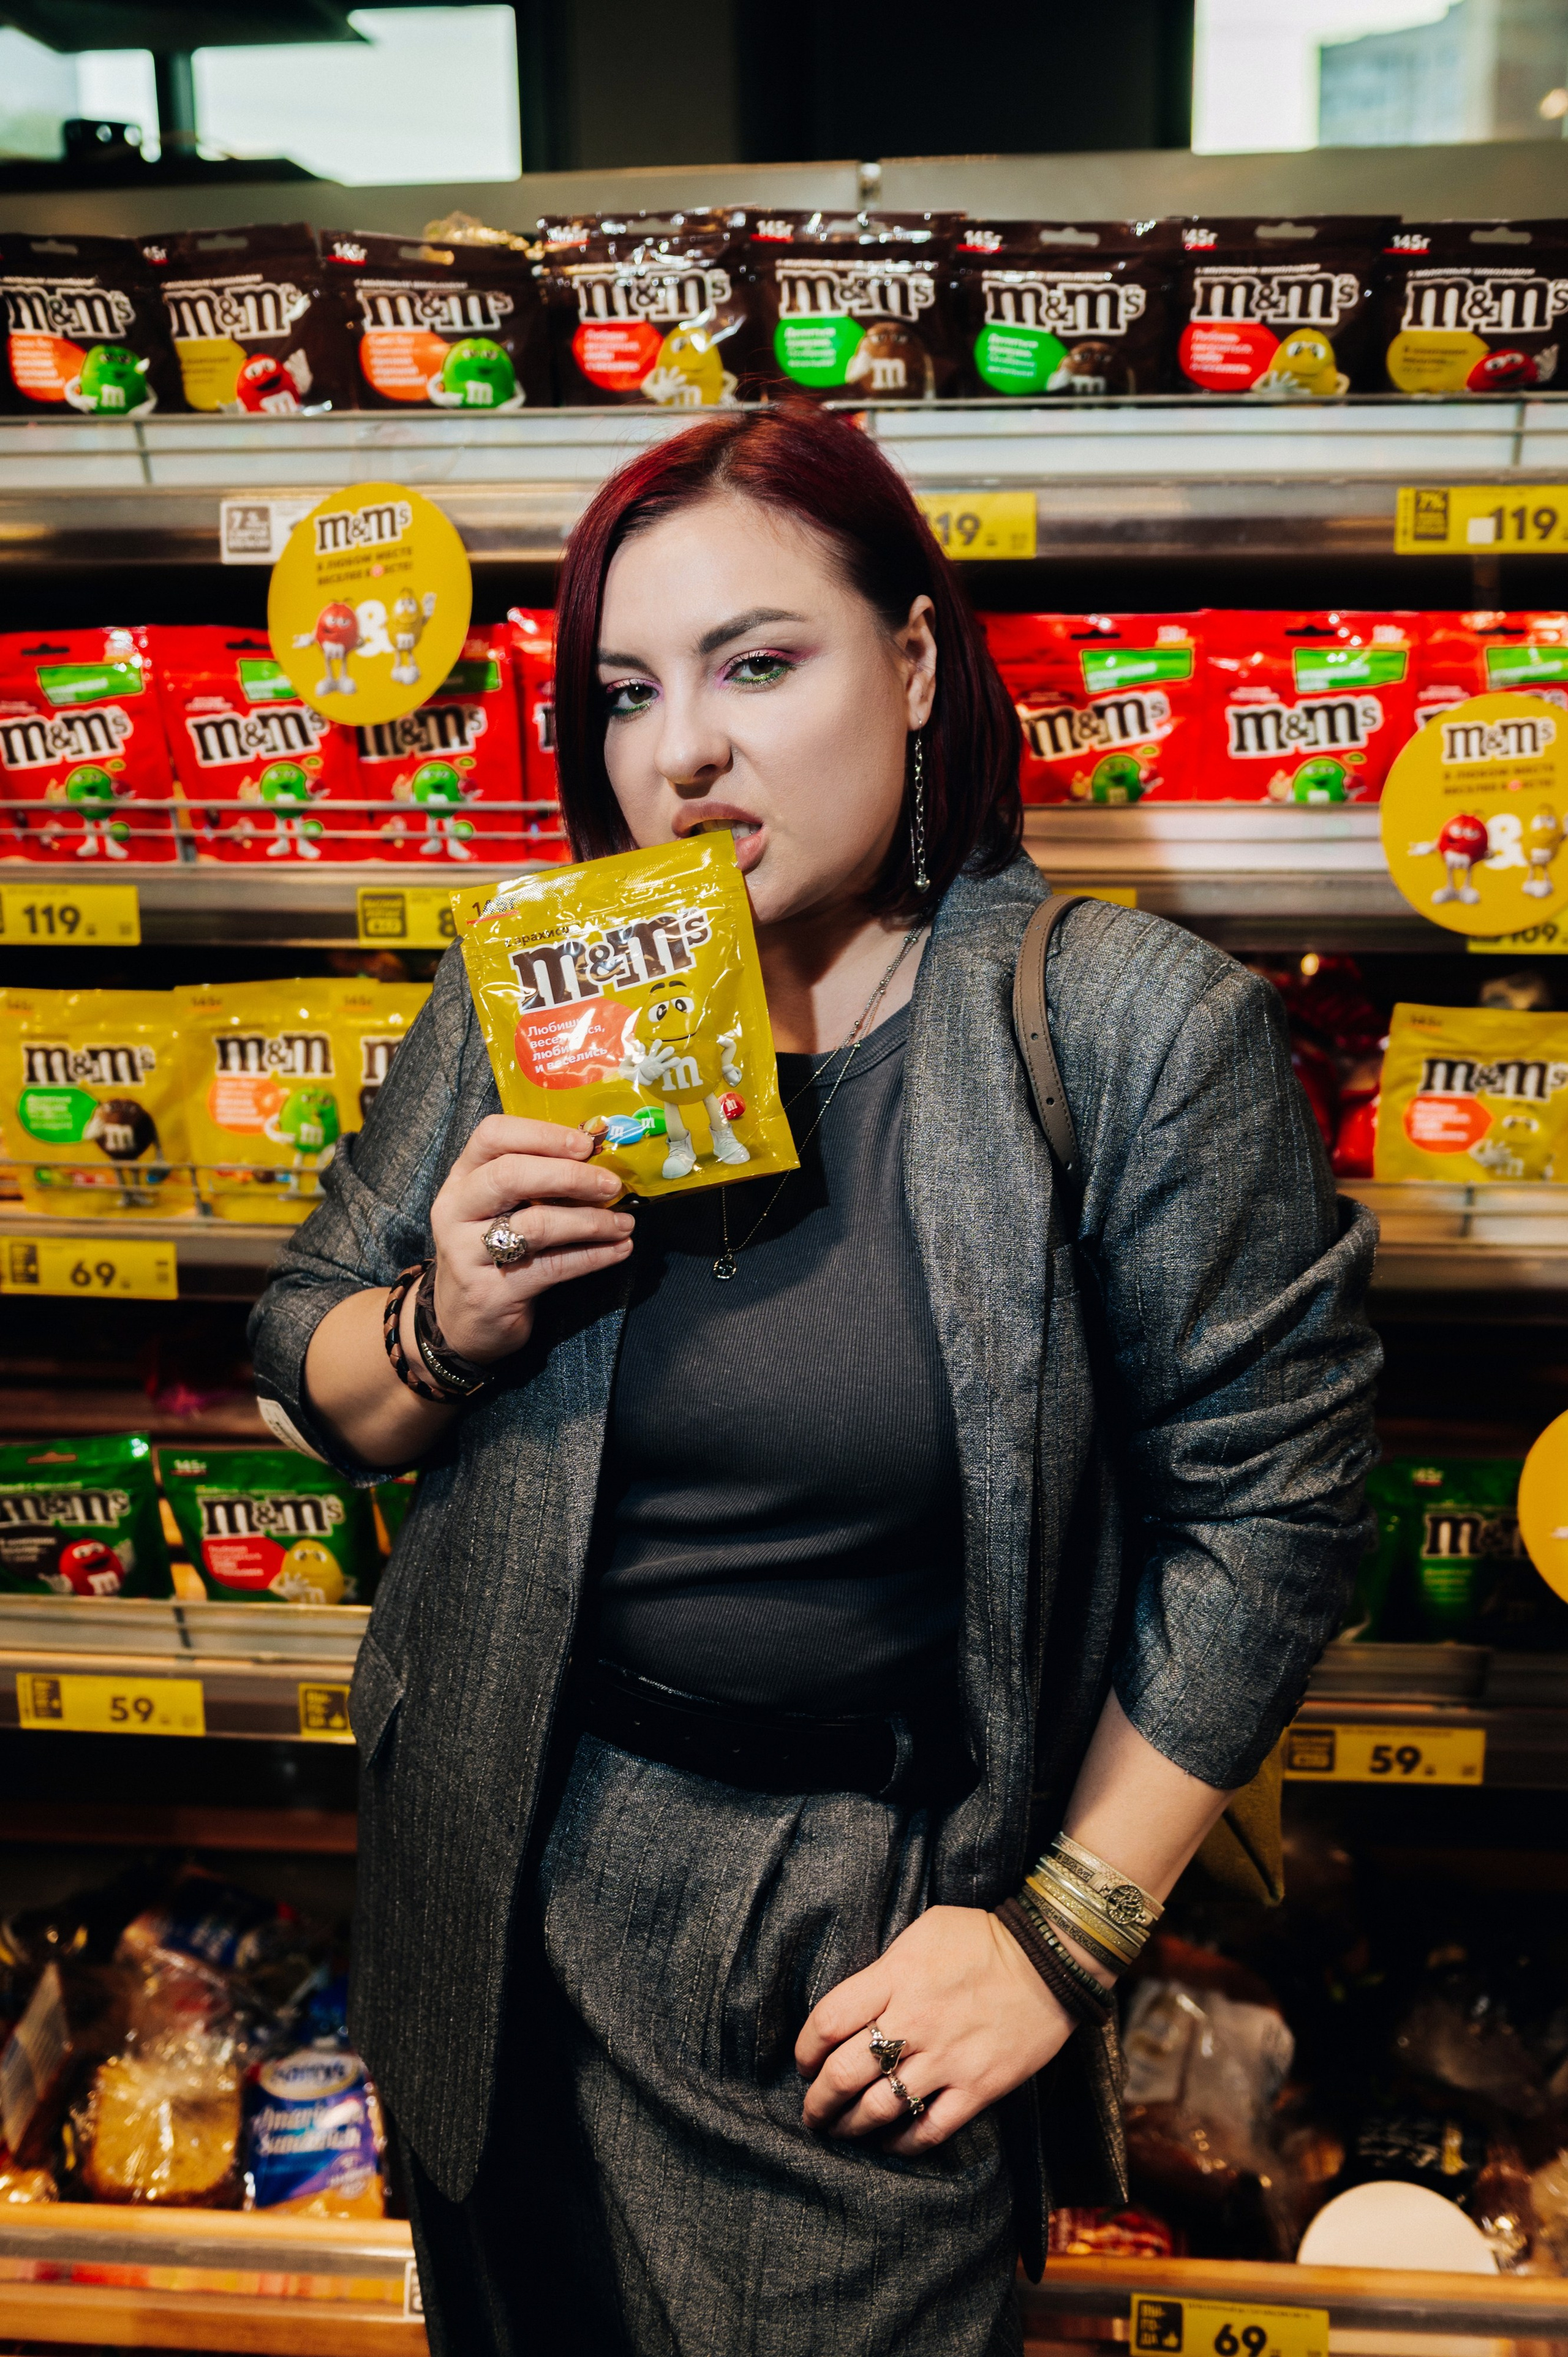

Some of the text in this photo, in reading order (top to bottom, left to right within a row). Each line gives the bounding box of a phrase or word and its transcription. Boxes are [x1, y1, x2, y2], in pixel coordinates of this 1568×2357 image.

[921, 511, 981, 546] 19
[1490, 506, 1558, 540] 119
[23, 904, 81, 935] 119
[514, 923, 580, 947] арахисо
[532, 1044, 570, 1062] люби
[535, 1048, 608, 1074] и веселись
[70, 1259, 116, 1288] 69
[110, 1695, 155, 1723] 59
[1369, 1744, 1422, 1775] 59
[1214, 2323, 1267, 2357] 69
